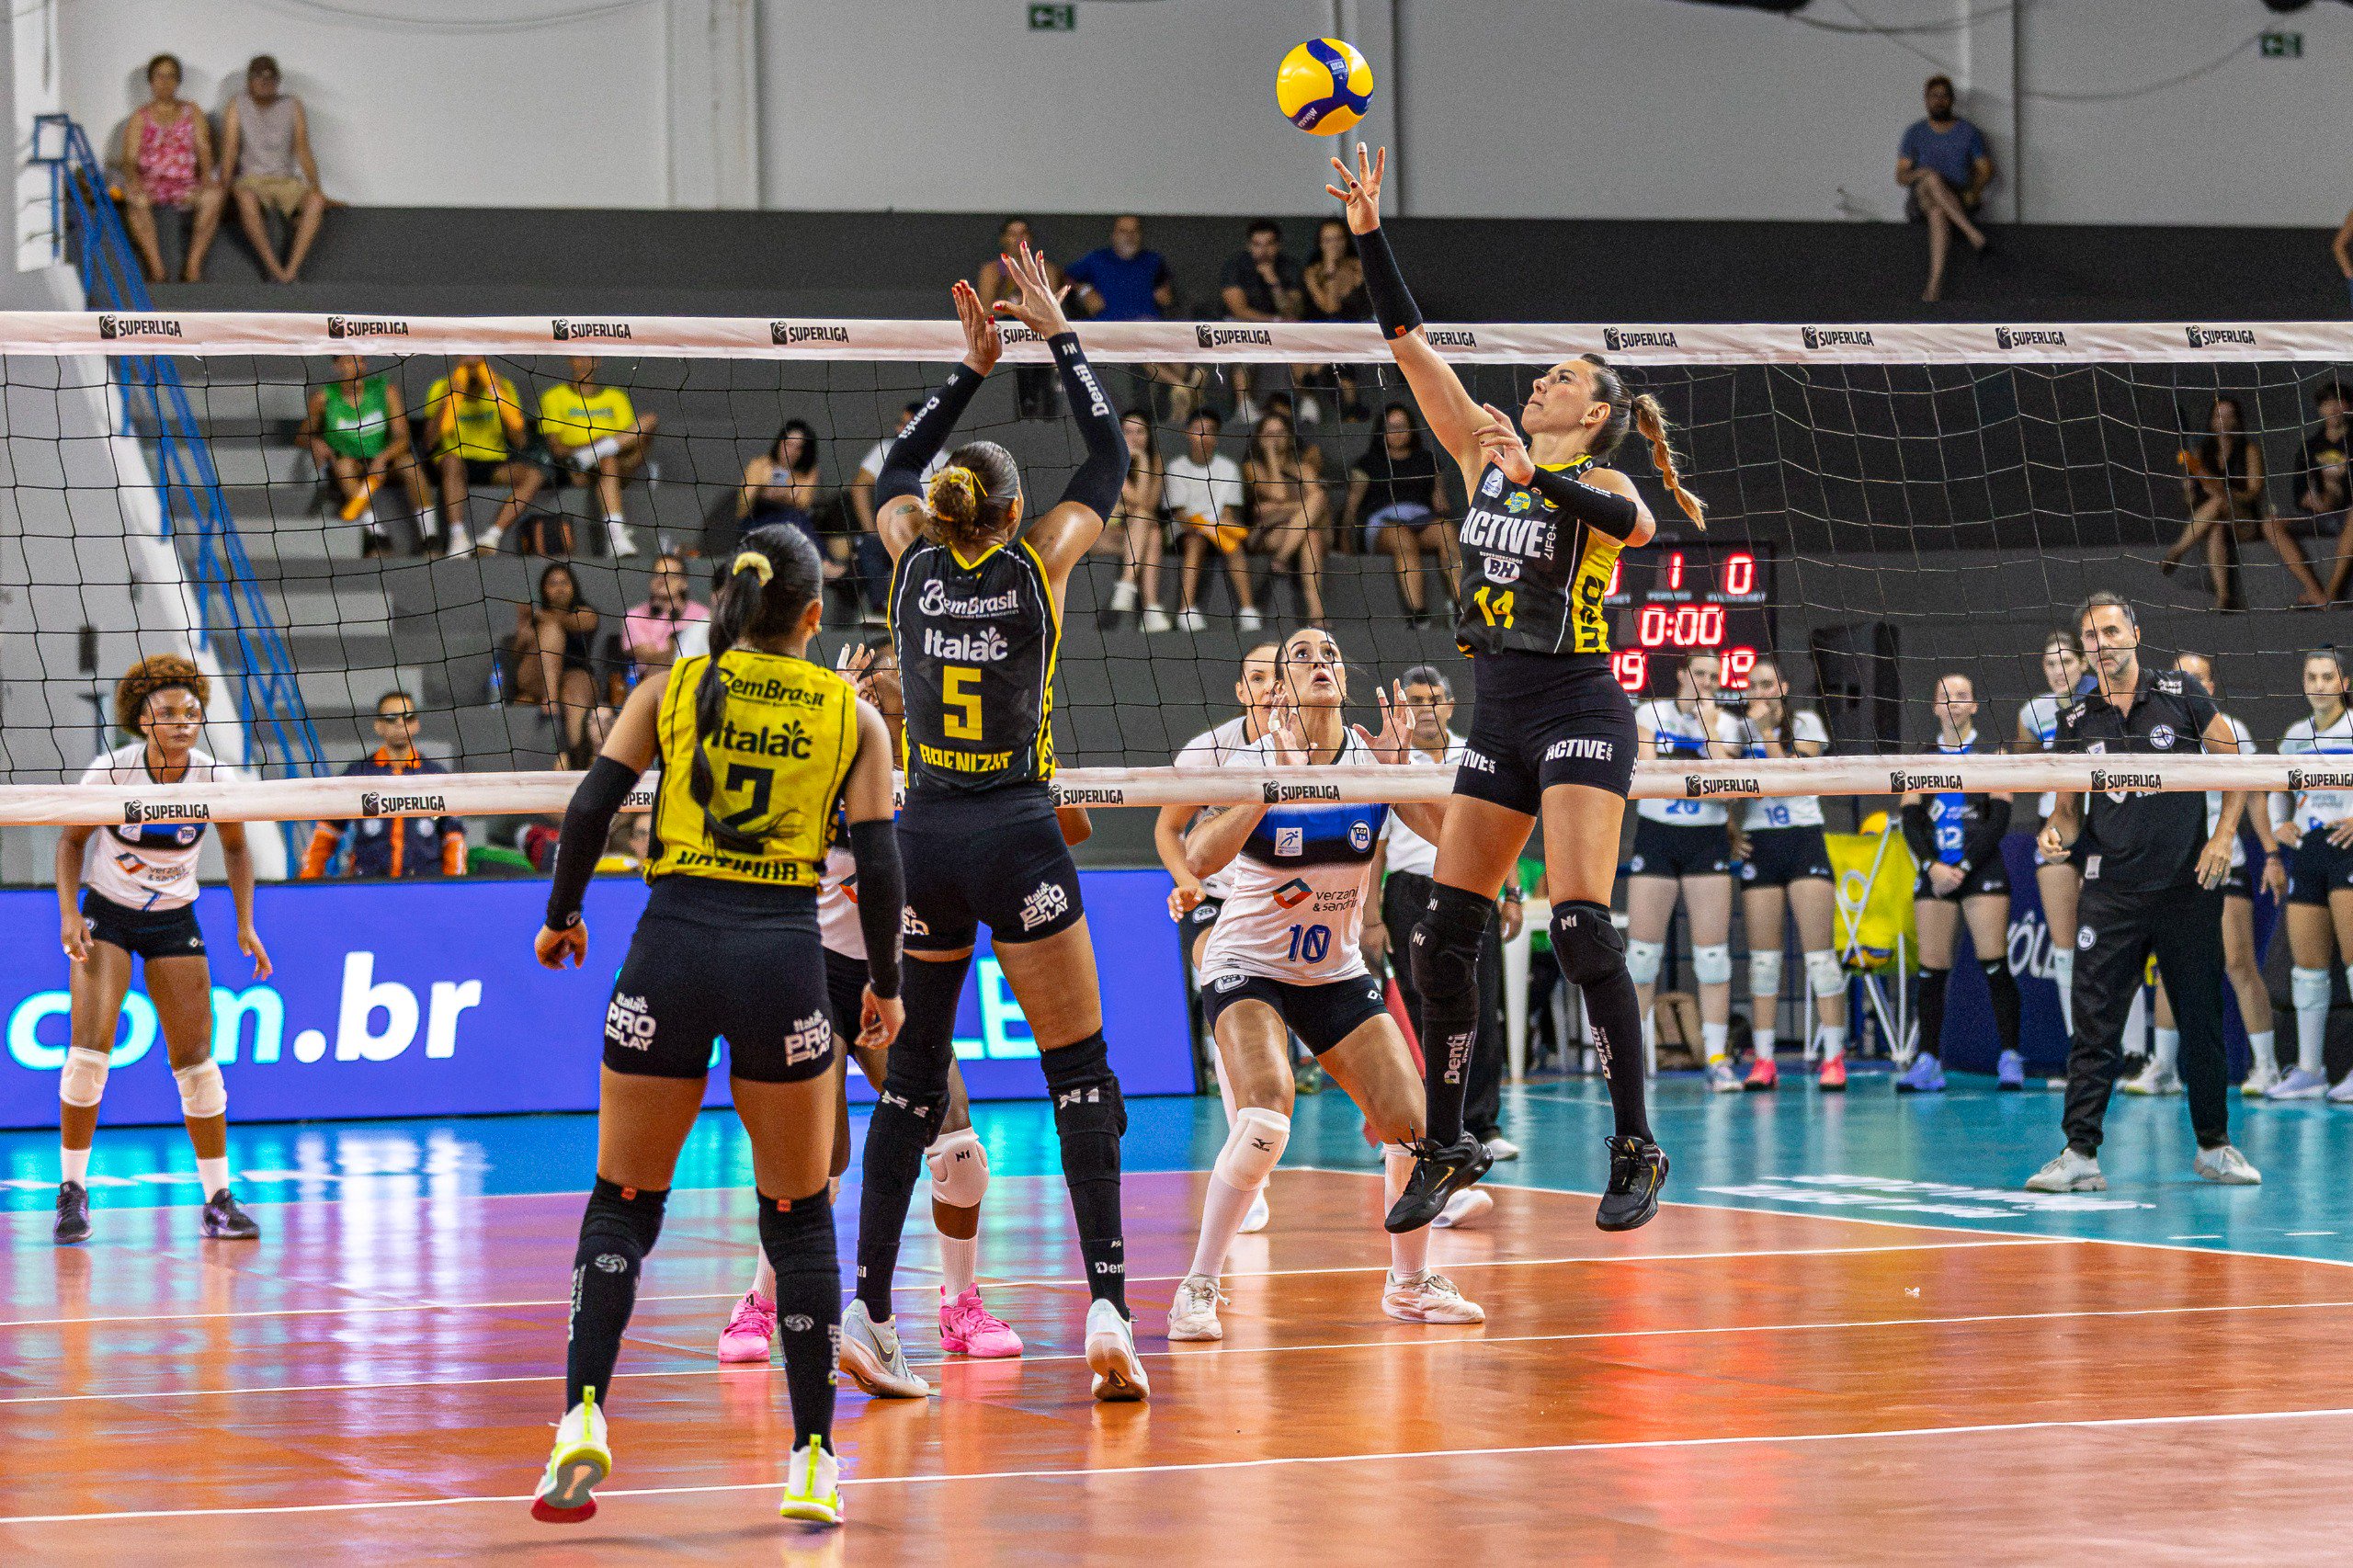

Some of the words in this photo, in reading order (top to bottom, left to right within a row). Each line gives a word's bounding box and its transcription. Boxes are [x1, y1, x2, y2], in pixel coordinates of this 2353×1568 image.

[119, 320, 183, 338] SUPERLIGA
[346, 322, 410, 337] SUPERLIGA
[570, 324, 632, 340] SUPERLIGA
[789, 326, 849, 344] SUPERLIGA
[1004, 328, 1046, 345] SUPERL
[1213, 329, 1273, 346] SUPERLIGA
[2201, 330, 2256, 346] SUPERLIGA
[1427, 331, 1477, 347] UPERLIGA
[1620, 332, 1678, 348] SUPERLIGA
[1818, 331, 1875, 347] SUPERLIGA
[2012, 331, 2067, 347] SUPERLIGA
[1073, 364, 1109, 416] Dentil
[1460, 506, 1546, 559] ACTIVE
[1487, 558, 1516, 578] BH
[1724, 553, 1755, 595] 0
[919, 578, 1019, 617] BemBrasil
[1474, 585, 1515, 630] 14
[1640, 605, 1724, 646] 0:00
[924, 626, 1008, 662] Italac
[942, 665, 983, 741] 5
[710, 720, 813, 760] Italac
[1545, 739, 1607, 762] ACTIVE
[1702, 778, 1760, 795] SUPERLIGA
[1907, 775, 1963, 791] SUPERLIGA
[2107, 774, 2162, 790] SUPERLIGA
[2303, 773, 2353, 789] SUPERLIG
[1063, 789, 1124, 805] SUPERLIGA
[1280, 785, 1341, 801] SUPERLIGA
[143, 803, 210, 822] SUPERLIGA
[381, 795, 446, 814] SUPERLIGA
[714, 762, 775, 856] 2
[1020, 884, 1065, 923] PRO
[1315, 887, 1358, 902] verzani
[1313, 903, 1321, 912] &
[1288, 924, 1333, 964] 10
[607, 1002, 656, 1039] PRO
[605, 1024, 653, 1051] PLAY
[784, 1018, 831, 1055] PRO
[1443, 1032, 1469, 1085] Dentil
[1095, 1261, 1124, 1274] Den
